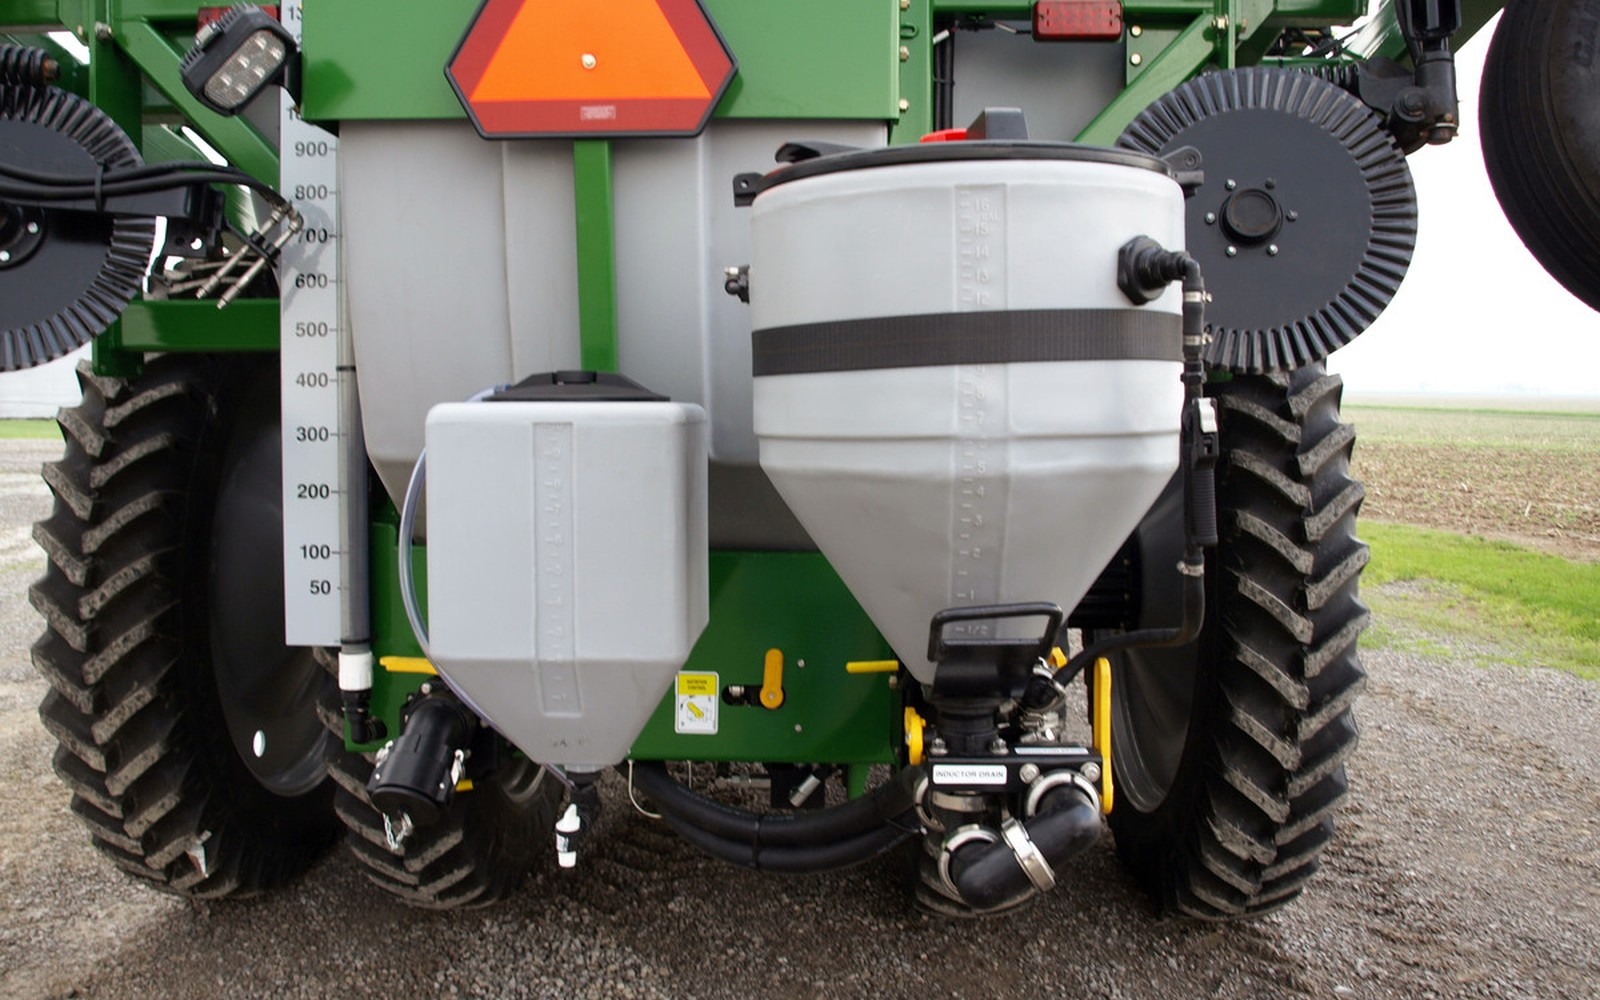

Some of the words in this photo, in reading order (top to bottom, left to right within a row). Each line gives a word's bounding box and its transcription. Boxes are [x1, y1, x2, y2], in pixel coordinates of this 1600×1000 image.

[294, 141, 328, 157] 900
[295, 185, 328, 200] 800
[299, 228, 328, 243] 700
[295, 273, 328, 289] 600
[295, 322, 328, 338] 500
[295, 372, 328, 388] 400
[296, 426, 329, 442] 300
[297, 484, 330, 500] 200
[300, 544, 331, 560] 100
[310, 579, 331, 595] 50
[936, 770, 977, 778] INDUCTOR
[978, 770, 1004, 778] DRAIN
